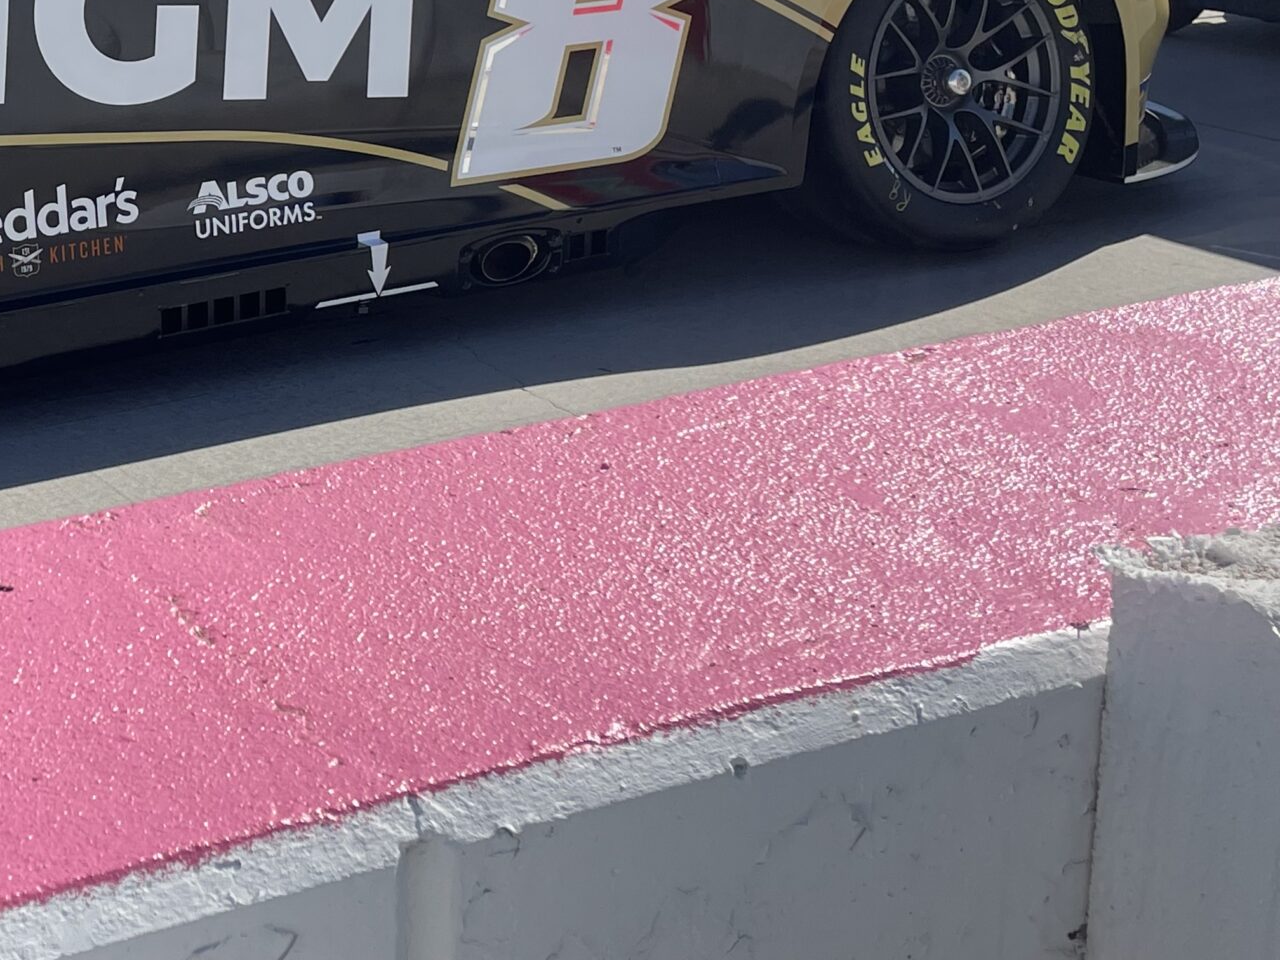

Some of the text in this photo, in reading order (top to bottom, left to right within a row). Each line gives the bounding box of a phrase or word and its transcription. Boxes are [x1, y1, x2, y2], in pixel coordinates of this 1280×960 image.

[849, 51, 885, 168] EAGLE
[187, 170, 315, 215] ALSCO
[194, 201, 317, 240] UNIFORMS
[48, 235, 125, 265] KITCHEN
